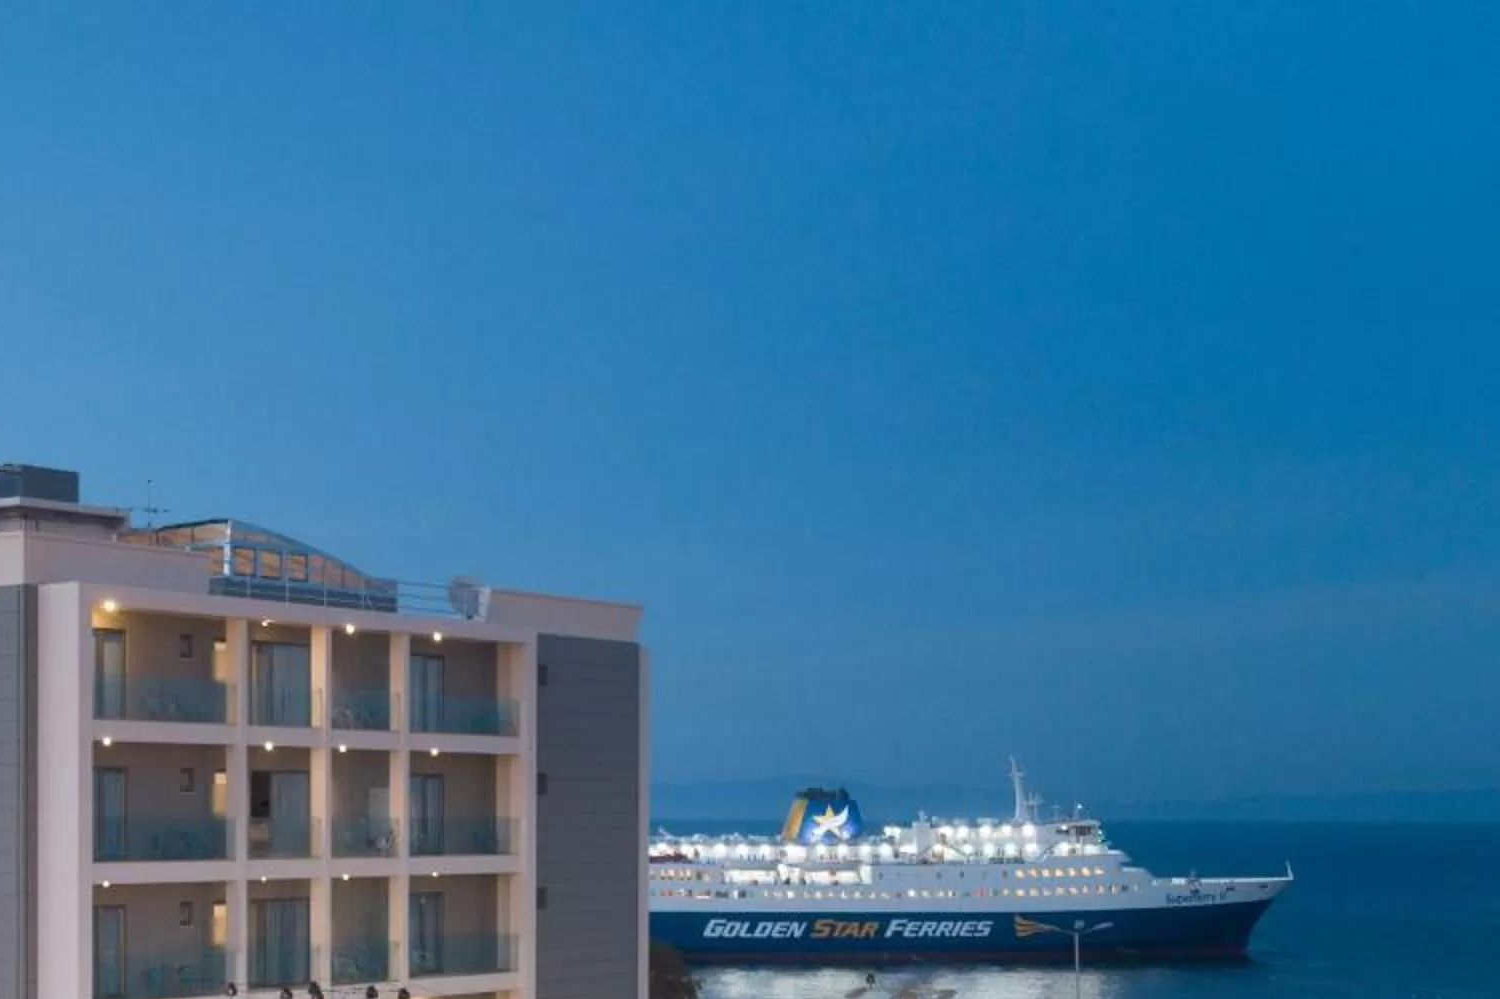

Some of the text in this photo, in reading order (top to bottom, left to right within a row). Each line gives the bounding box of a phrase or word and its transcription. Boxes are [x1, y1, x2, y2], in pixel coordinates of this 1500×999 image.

[703, 918, 995, 938] GOLDEN STAR FERRIES
